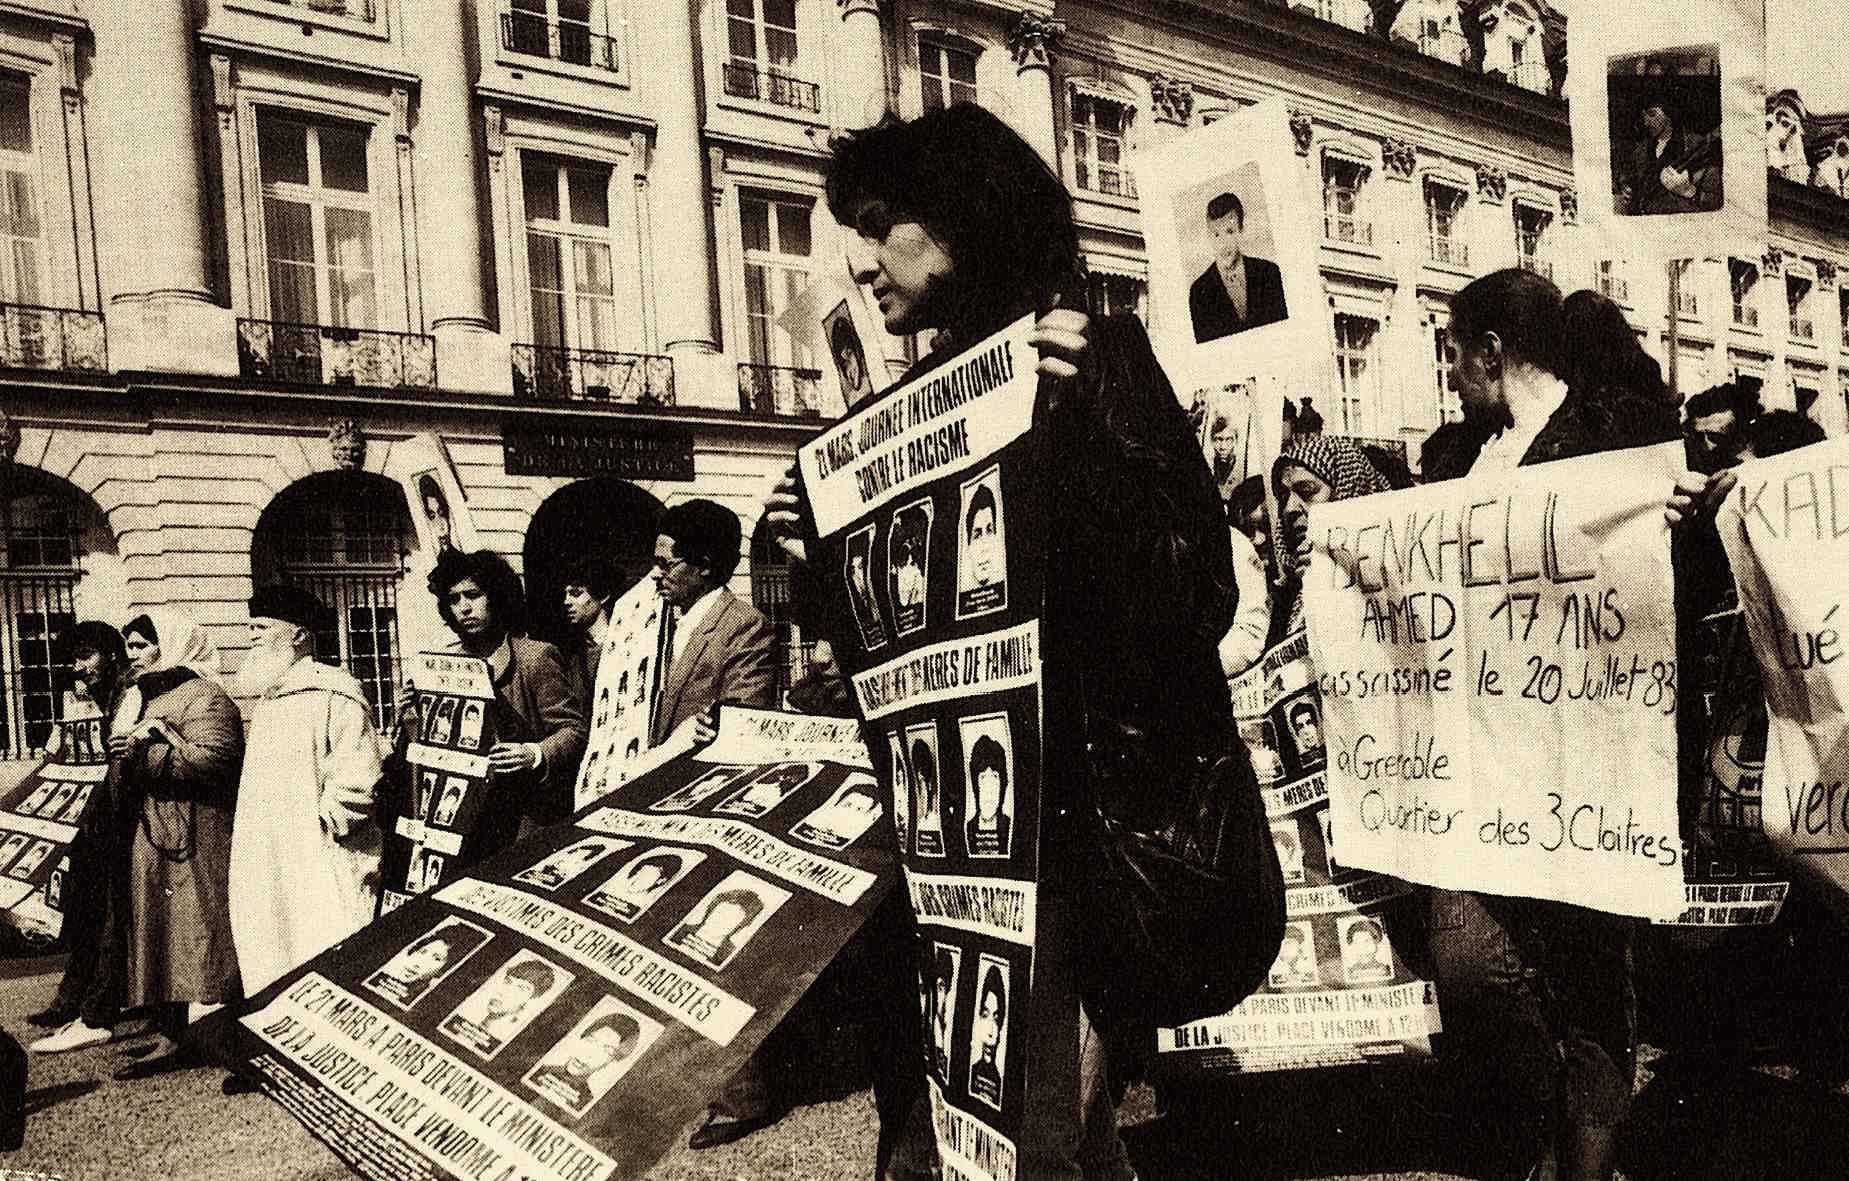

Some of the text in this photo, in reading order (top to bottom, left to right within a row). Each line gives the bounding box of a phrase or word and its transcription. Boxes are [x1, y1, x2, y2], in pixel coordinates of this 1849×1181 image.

[814, 448, 830, 480] 21
[907, 340, 1015, 429] INTERNATIONALE
[892, 445, 906, 484] LE
[908, 417, 971, 478] RACISME
[1490, 592, 1541, 642] 17
[1556, 587, 1626, 650] ANS
[963, 646, 982, 685] DE
[985, 632, 1033, 682] FAMILLE
[1477, 650, 1504, 697] le
[1521, 655, 1562, 704] 20
[1568, 653, 1648, 701] Juillet
[1643, 661, 1676, 715] 83
[1360, 788, 1464, 835] Quartier
[1479, 807, 1531, 846] des
[1539, 792, 1564, 851] 3
[574, 928, 638, 977] CRIMES
[634, 961, 721, 1023] RACISTES
[1174, 1027, 1190, 1049] DE
[1193, 1025, 1210, 1047] LA
[1251, 998, 1290, 1017] PARIS
[324, 998, 377, 1041] MARS
[377, 1031, 436, 1077] PARIS
[420, 1058, 494, 1115] DEVANT
[479, 1096, 513, 1128] LE
[497, 1108, 605, 1181] MINISTERE
[364, 1080, 428, 1131] PLACE
